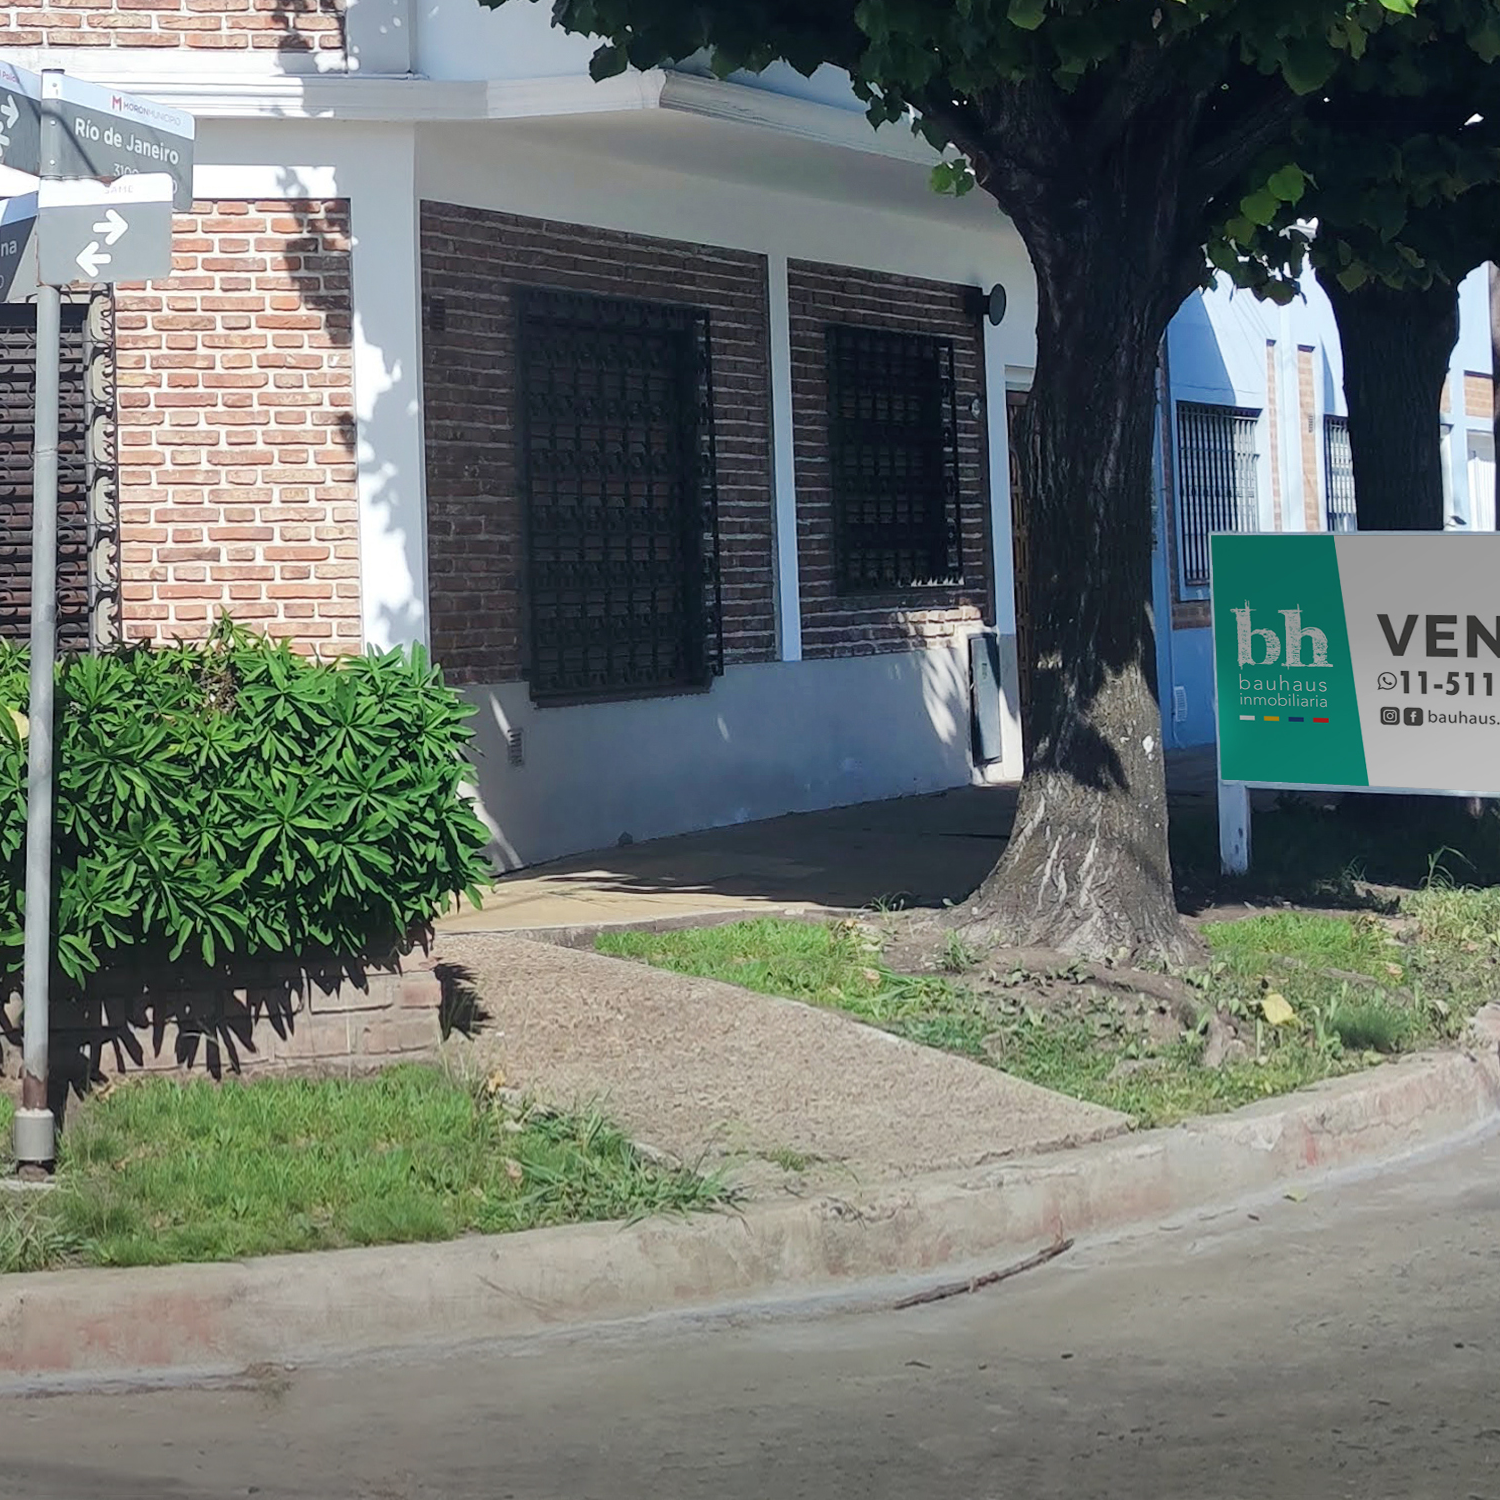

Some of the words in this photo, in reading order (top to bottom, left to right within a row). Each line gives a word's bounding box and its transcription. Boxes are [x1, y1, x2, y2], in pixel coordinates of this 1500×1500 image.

[74, 117, 100, 141] Río
[104, 126, 122, 148] de
[126, 134, 179, 165] Janeiro
[1230, 599, 1333, 670] bh
[1377, 613, 1500, 659] VEN
[1238, 674, 1328, 693] bauhaus
[1239, 693, 1328, 708] inmobiliaria
[1400, 670, 1494, 697] 11-511
